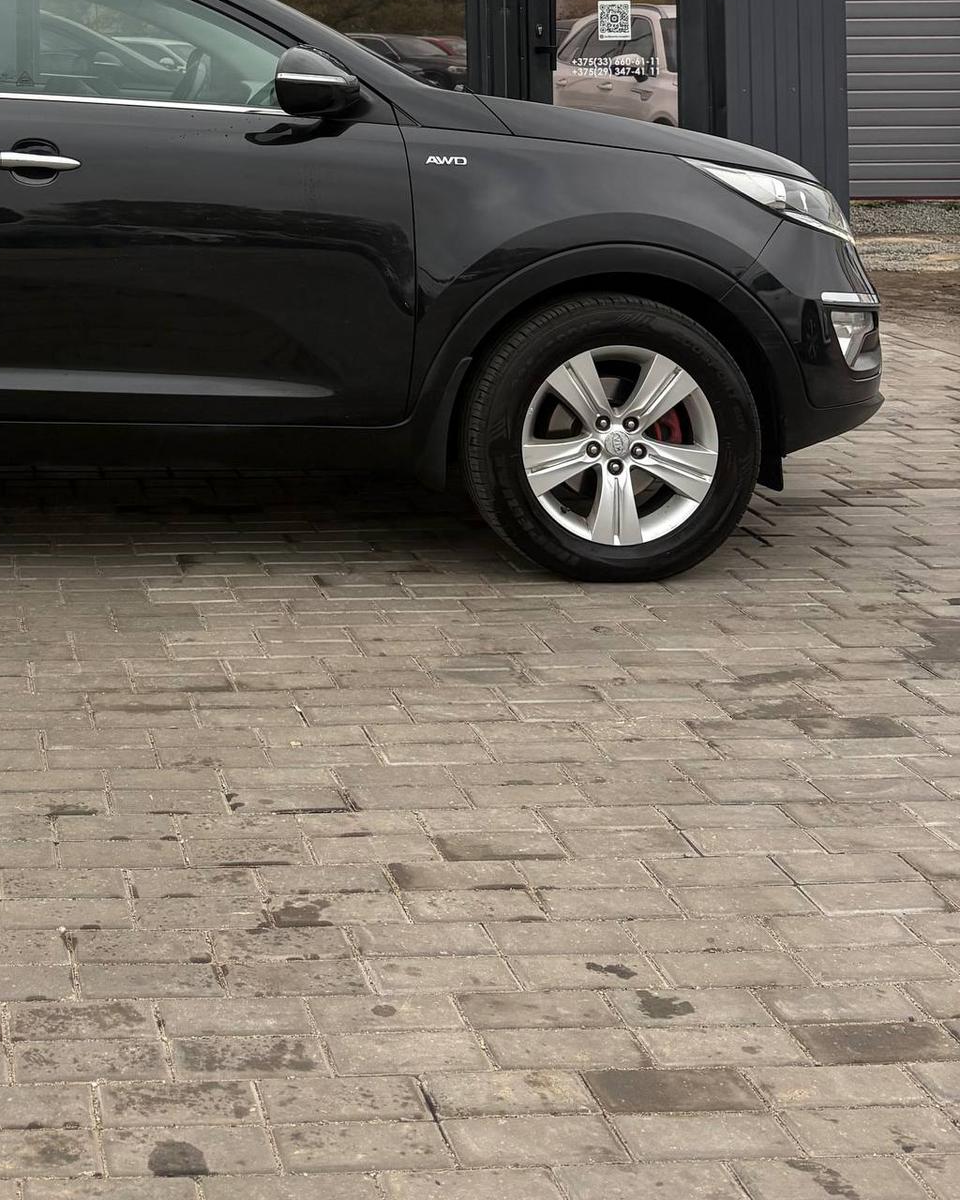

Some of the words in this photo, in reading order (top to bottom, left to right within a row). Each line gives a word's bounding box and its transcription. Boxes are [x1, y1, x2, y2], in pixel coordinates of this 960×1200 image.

[572, 57, 612, 68] +375(33)
[572, 66, 612, 77] +375(29)
[425, 155, 468, 166] AWD
